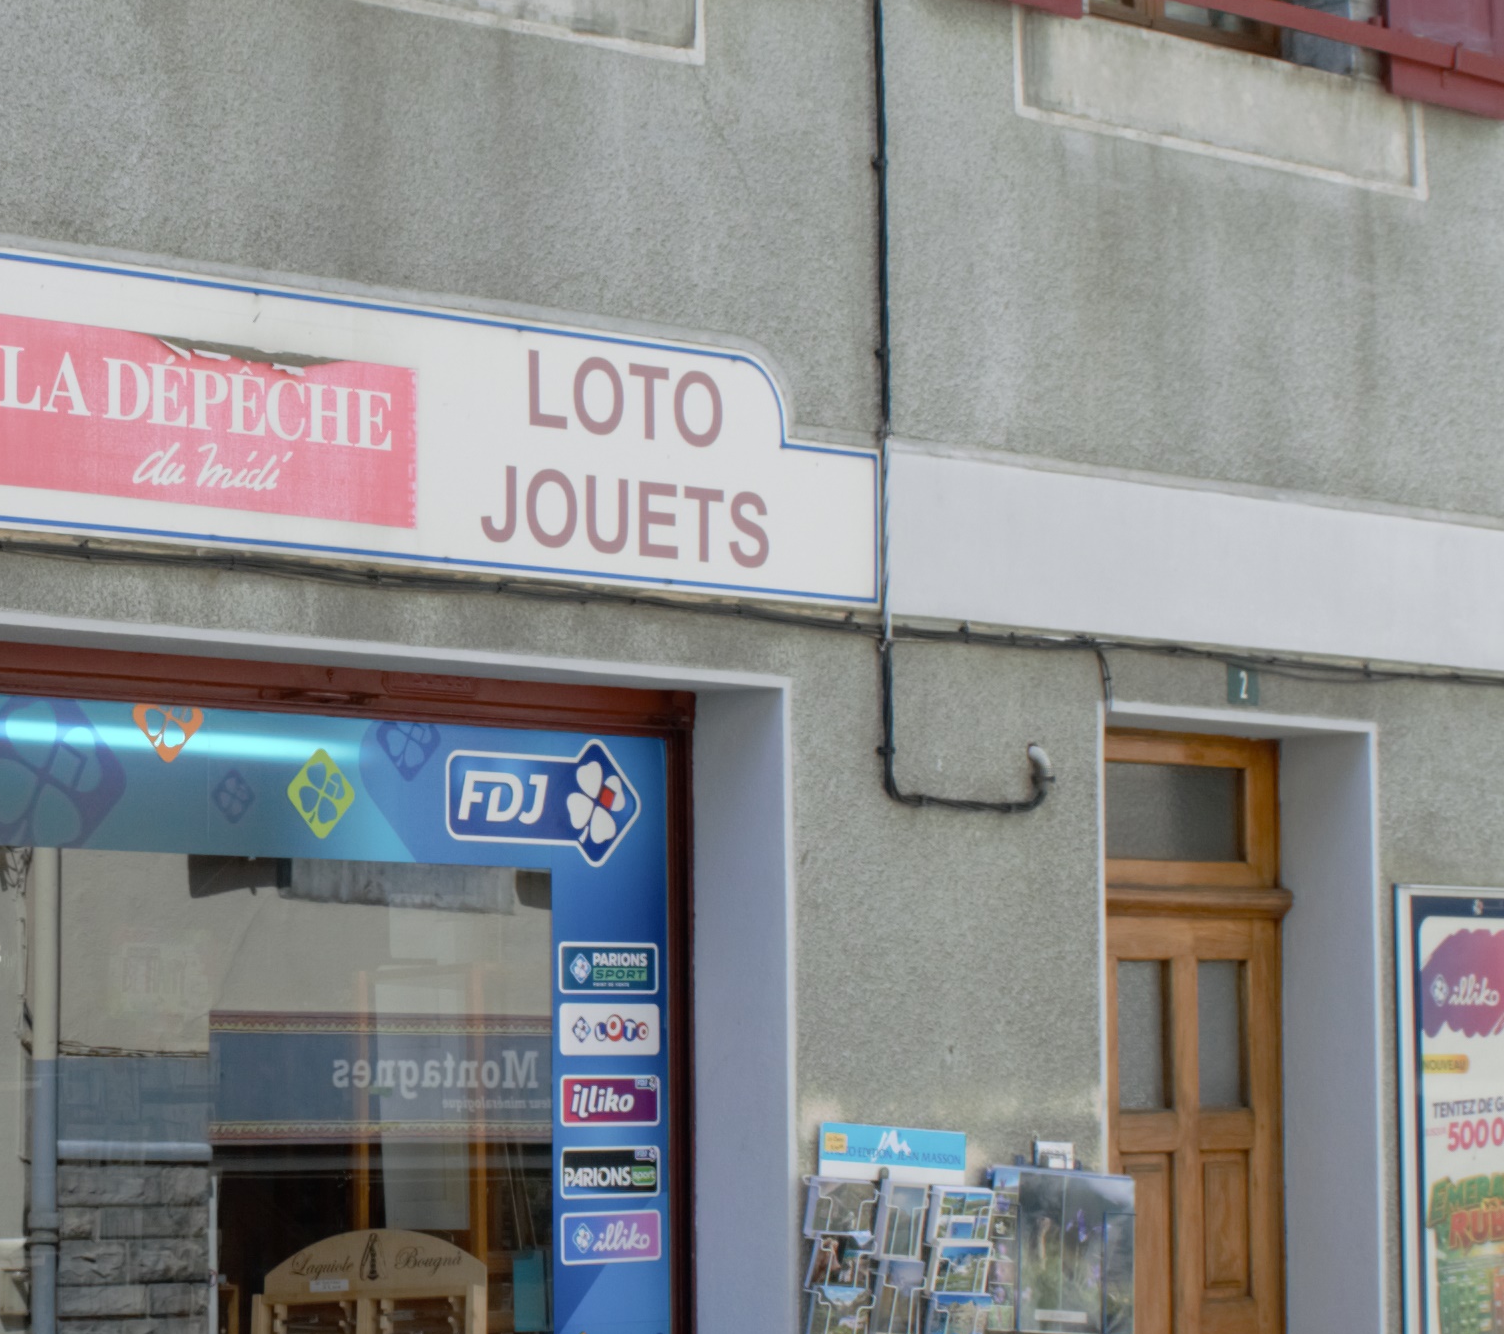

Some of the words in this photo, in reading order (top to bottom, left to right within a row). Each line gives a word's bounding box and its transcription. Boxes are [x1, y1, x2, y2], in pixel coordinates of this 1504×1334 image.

[102, 354, 393, 452] DÉPÊCHE
[528, 349, 722, 449] LOTO
[132, 441, 187, 487] du
[480, 468, 770, 570] JOUETS
[457, 770, 549, 826] FDJ
[592, 951, 648, 968] PARIONS
[594, 969, 647, 982] SPORT
[1448, 974, 1500, 1006] illiko
[594, 1013, 649, 1042] LOTO
[1422, 1059, 1467, 1073] NOUVEAU
[571, 1081, 635, 1117] illiko
[1432, 1099, 1475, 1118] TENTEZ
[1477, 1097, 1493, 1113] DE
[1447, 1119, 1490, 1152] 500
[896, 1150, 920, 1163] JEAN
[921, 1151, 962, 1165] MASSON
[564, 1165, 632, 1188] PARIONS
[633, 1167, 657, 1184] sport
[592, 1220, 651, 1253] illiko
[289, 1252, 354, 1280] Laguiole
